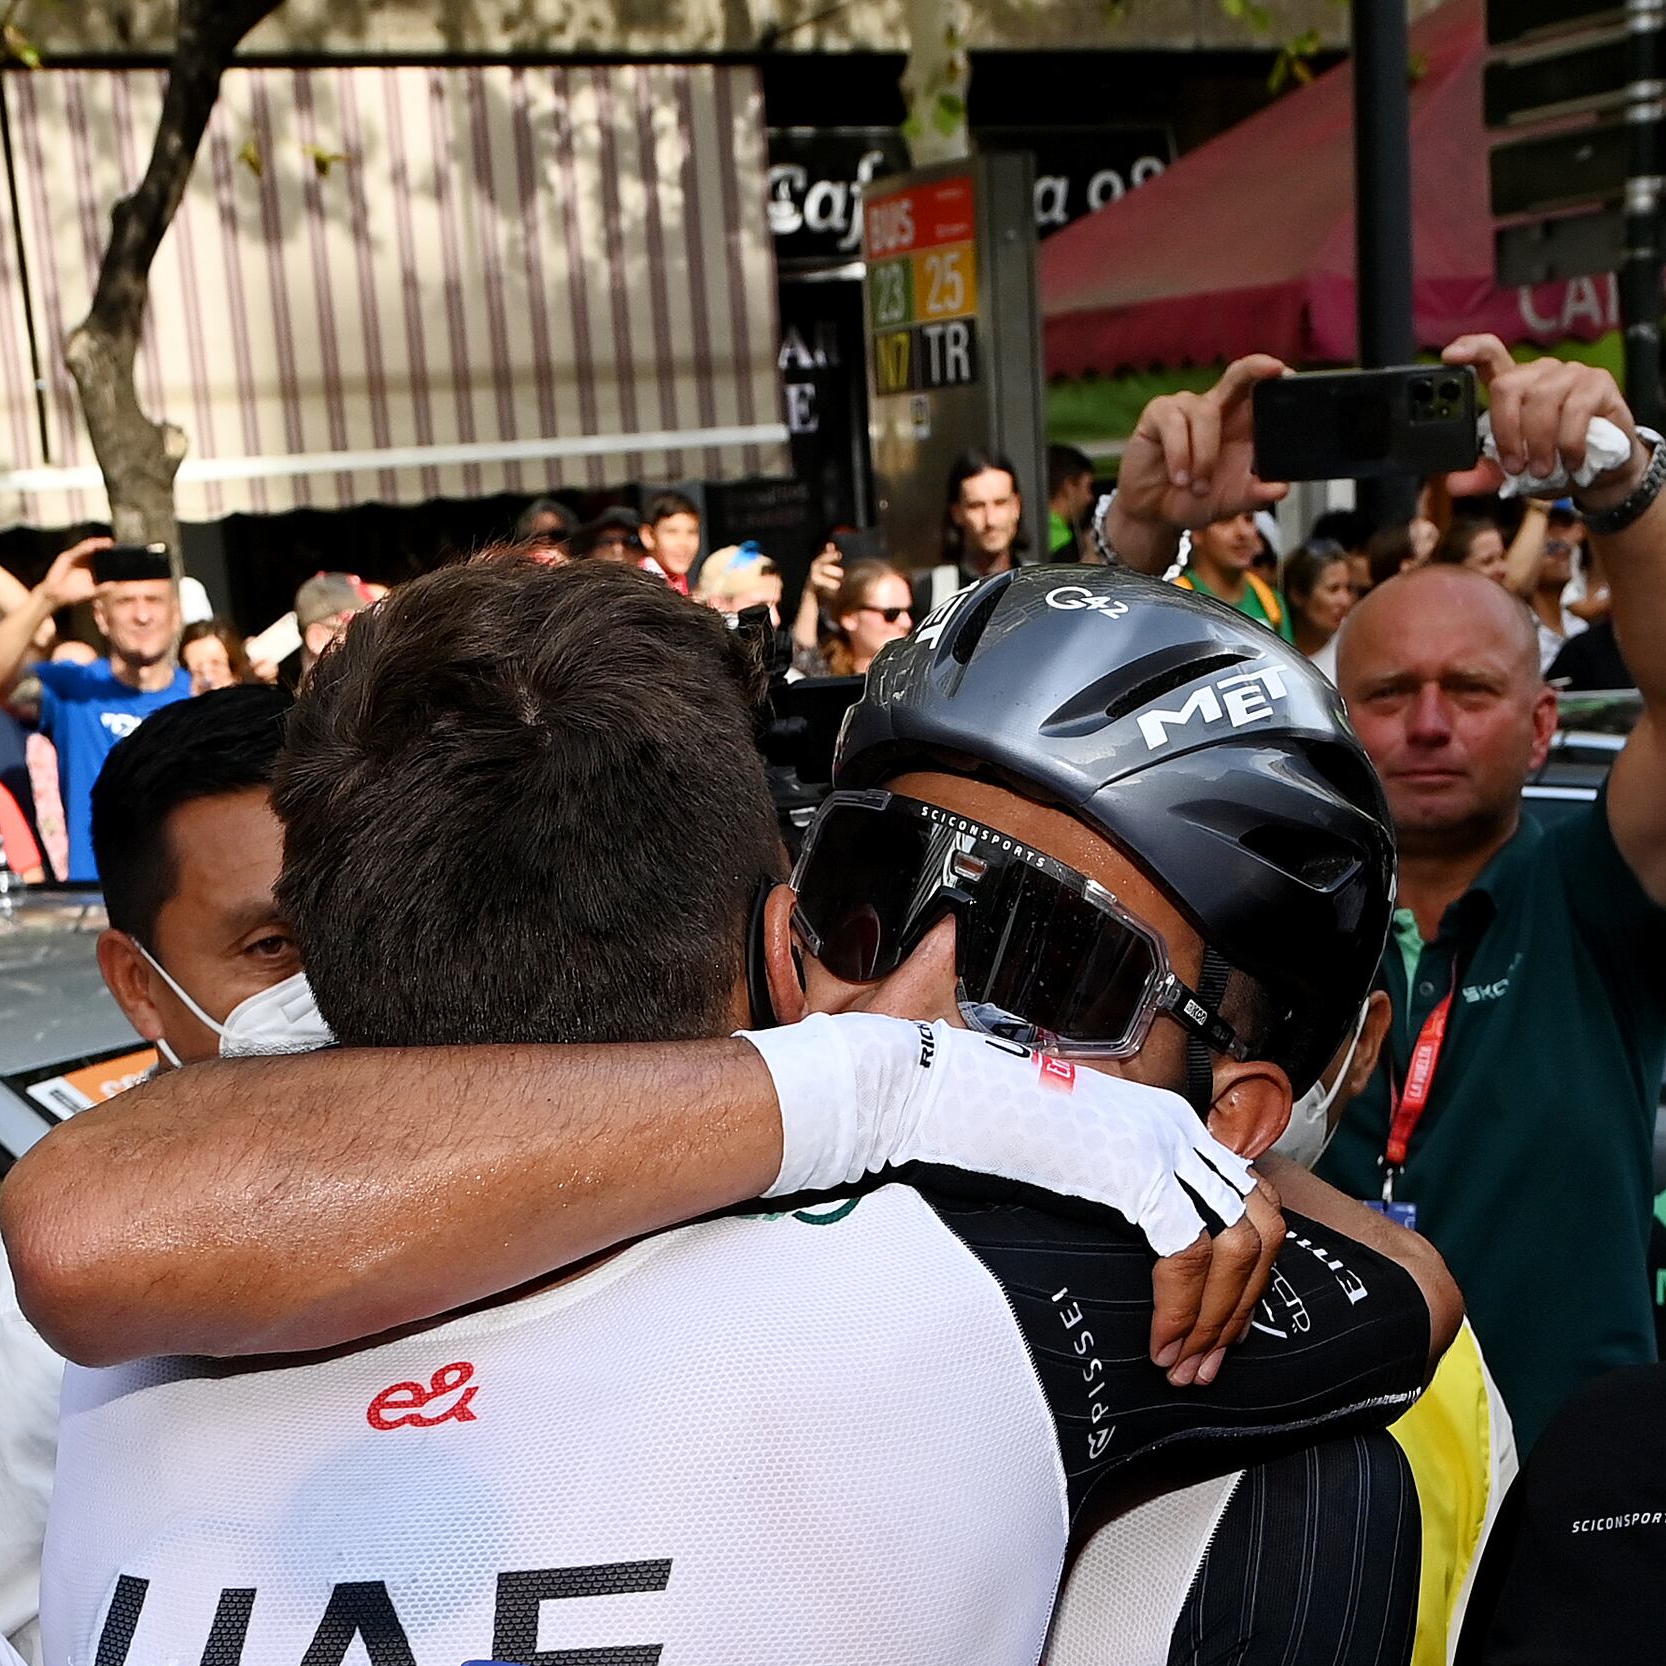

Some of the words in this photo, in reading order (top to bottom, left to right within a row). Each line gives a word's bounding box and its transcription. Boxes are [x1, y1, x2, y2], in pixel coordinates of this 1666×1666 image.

[924, 252, 966, 316] 25
[921, 320, 971, 385] TR
[1045, 585, 1130, 619] G42
[1135, 663, 1289, 750] MET
[920, 804, 1047, 869] SCICONSPORTS
